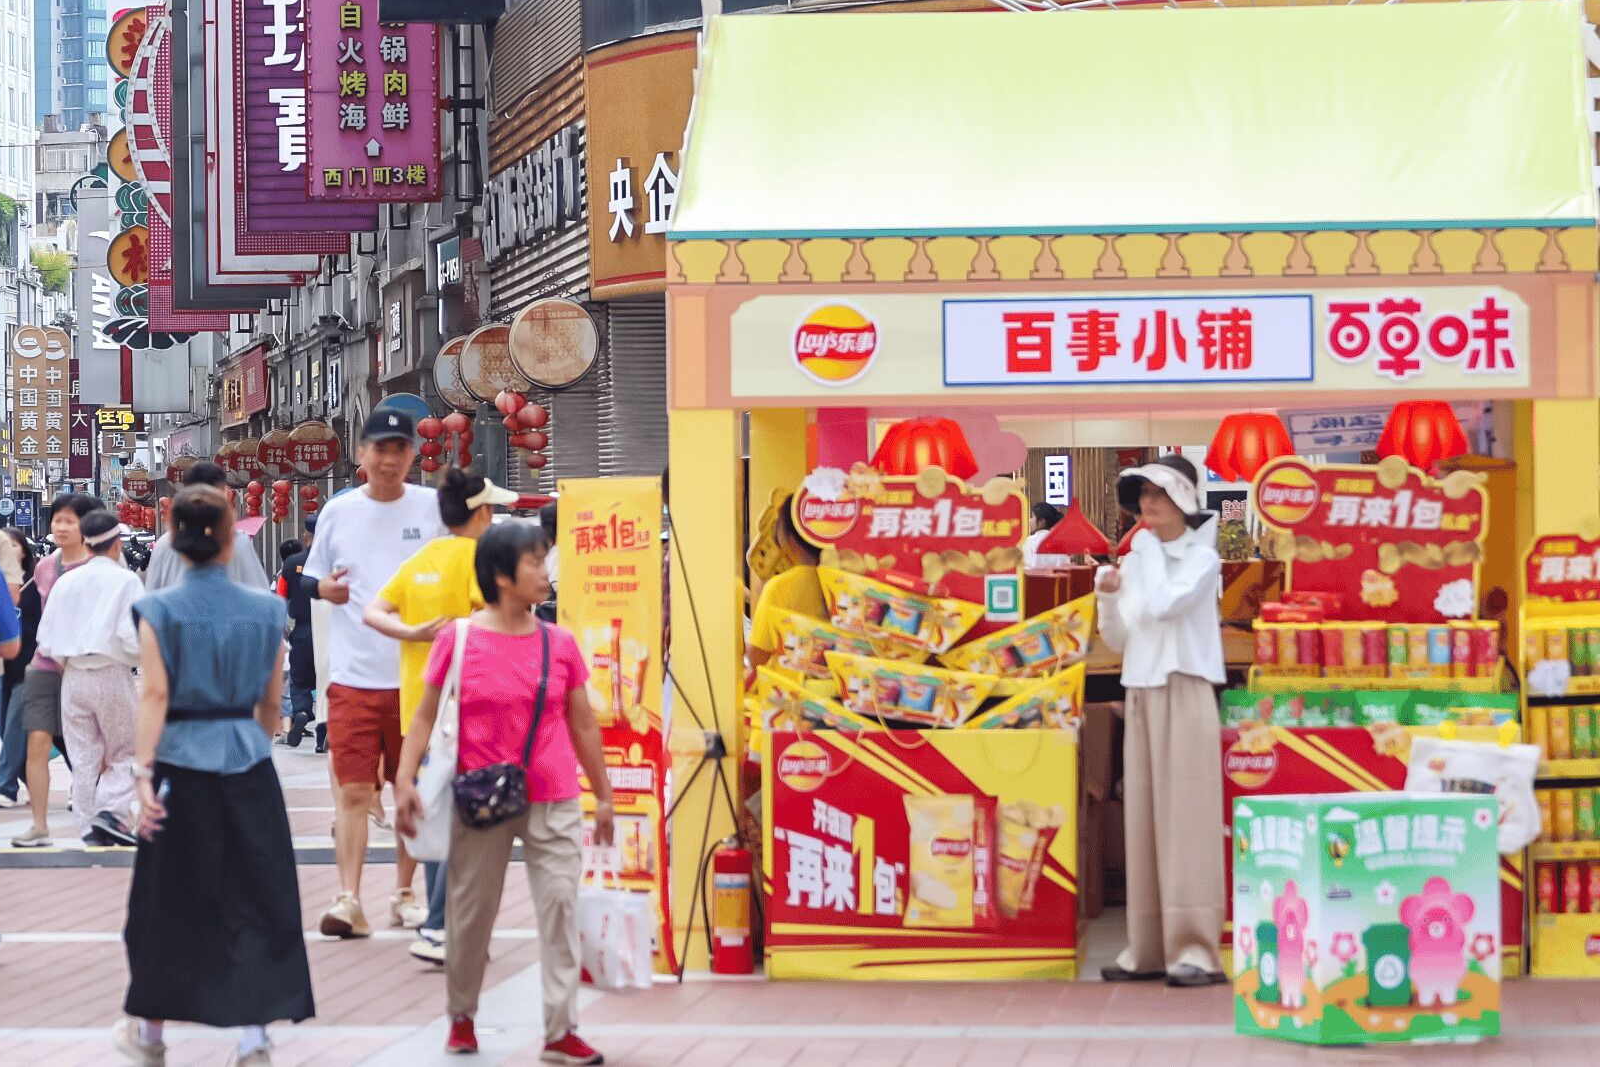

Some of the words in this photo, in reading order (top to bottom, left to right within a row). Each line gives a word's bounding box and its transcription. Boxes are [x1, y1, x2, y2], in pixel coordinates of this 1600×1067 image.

[322, 165, 428, 187] 西门町3楼
[1002, 306, 1253, 373] 百事小铺
[18, 365, 39, 455] 中国黄金
[45, 367, 64, 454] 中国黄金
